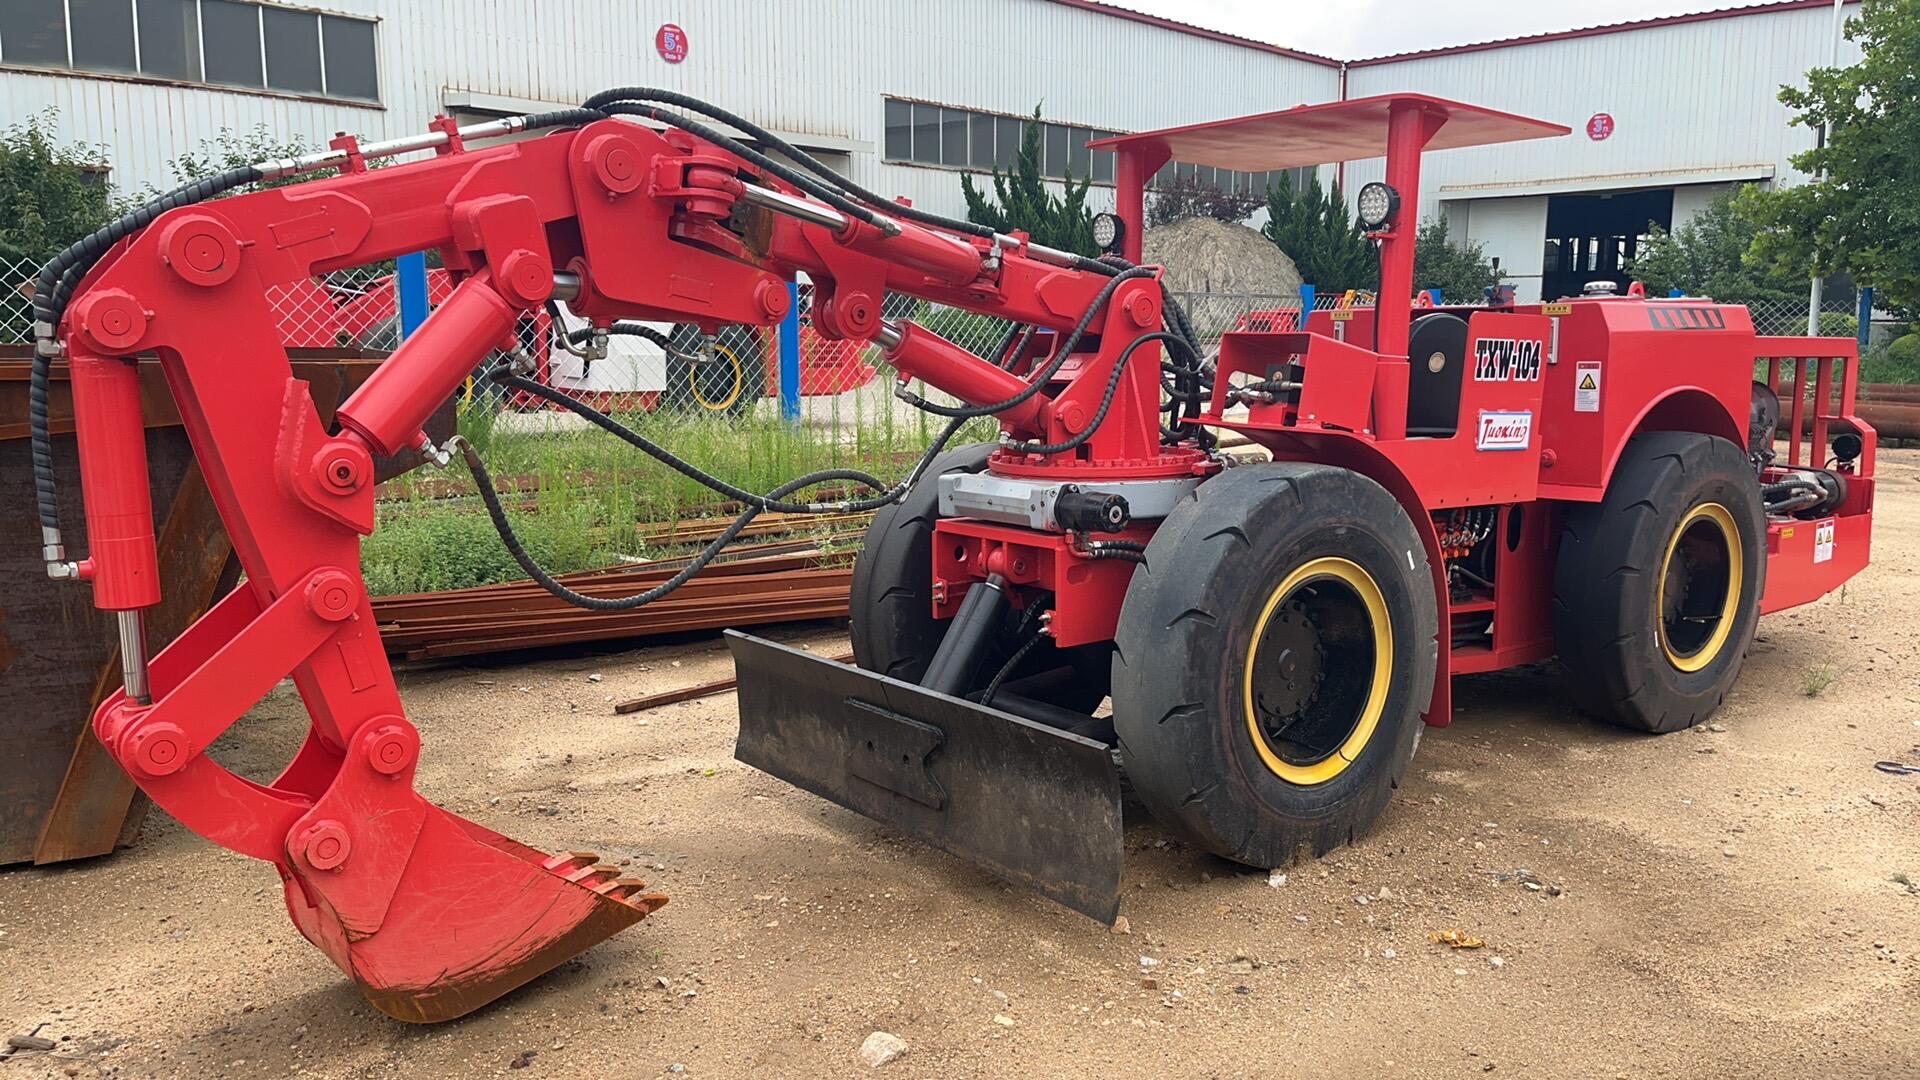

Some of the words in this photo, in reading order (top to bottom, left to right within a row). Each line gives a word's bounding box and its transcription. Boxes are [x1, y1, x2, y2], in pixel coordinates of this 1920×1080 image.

[664, 32, 675, 50] 5
[1475, 339, 1541, 380] TXW-104
[1481, 419, 1527, 444] Tuoxing
